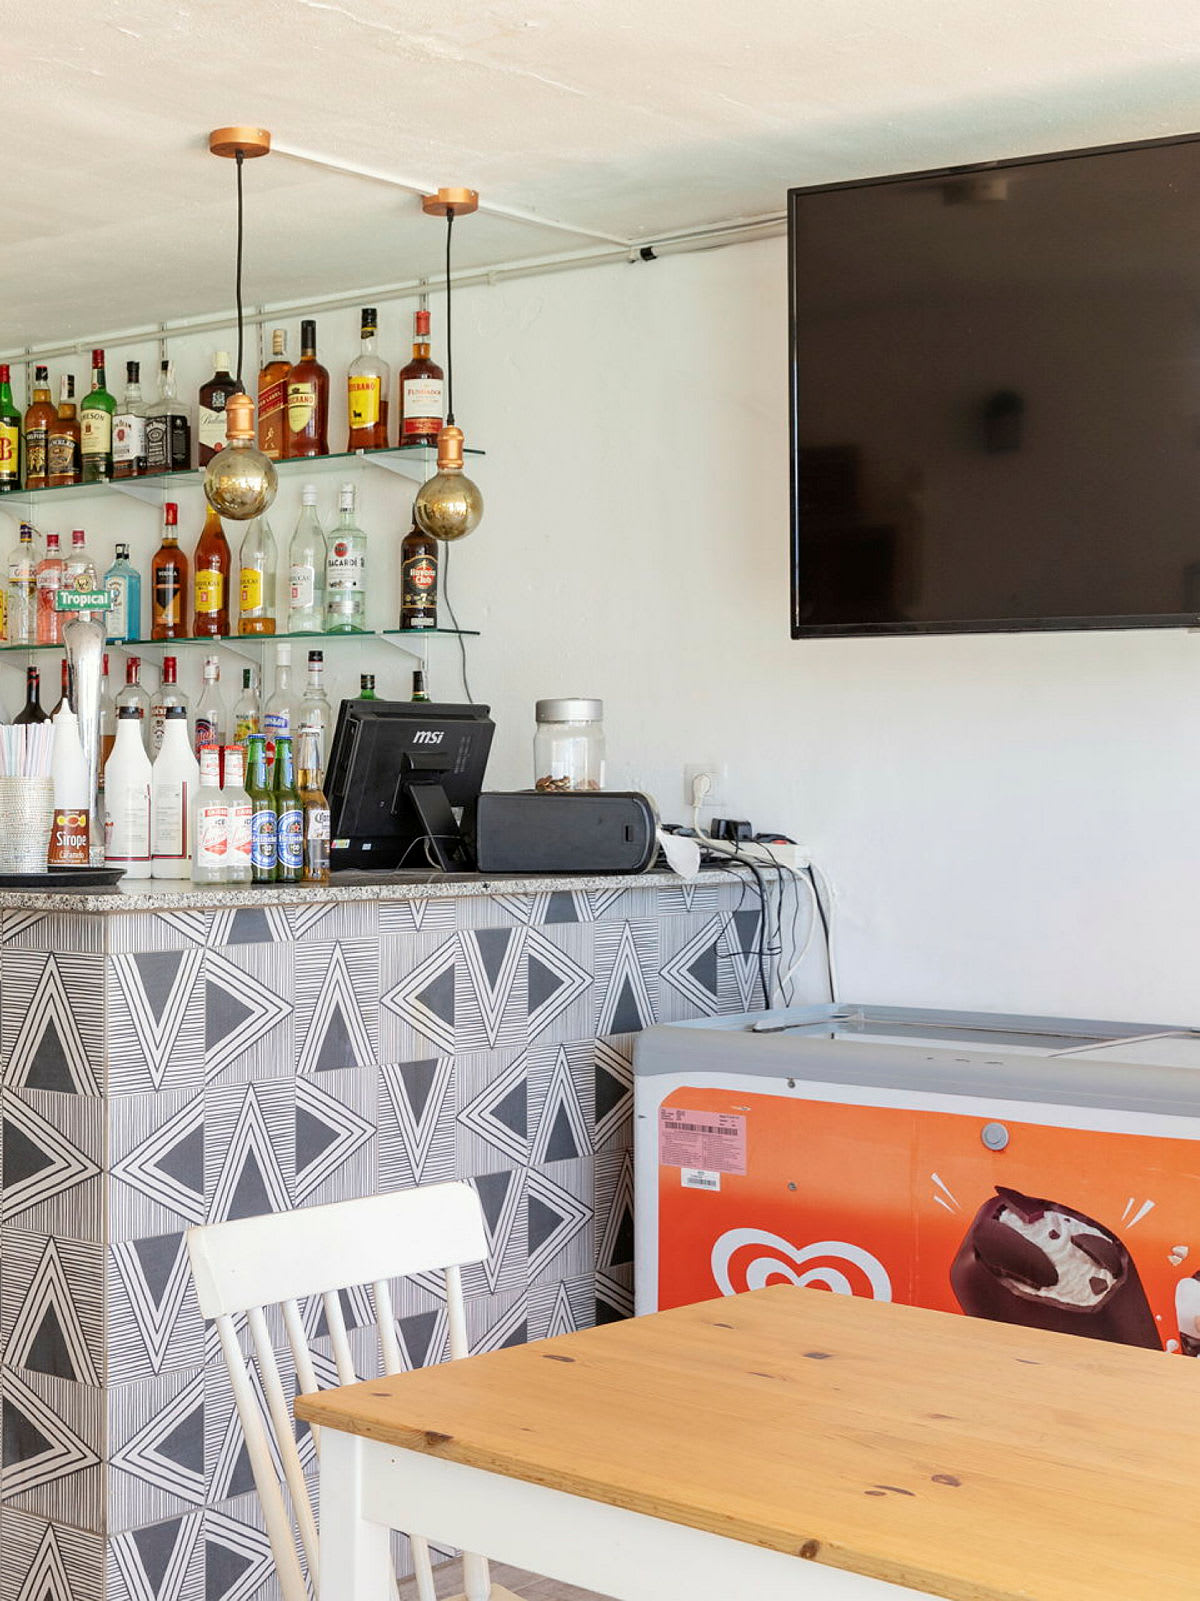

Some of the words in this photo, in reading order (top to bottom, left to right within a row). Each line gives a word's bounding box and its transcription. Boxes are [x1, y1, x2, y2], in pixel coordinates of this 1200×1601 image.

[61, 592, 109, 607] Tropical
[412, 730, 445, 744] msi
[56, 831, 87, 850] Sirope
